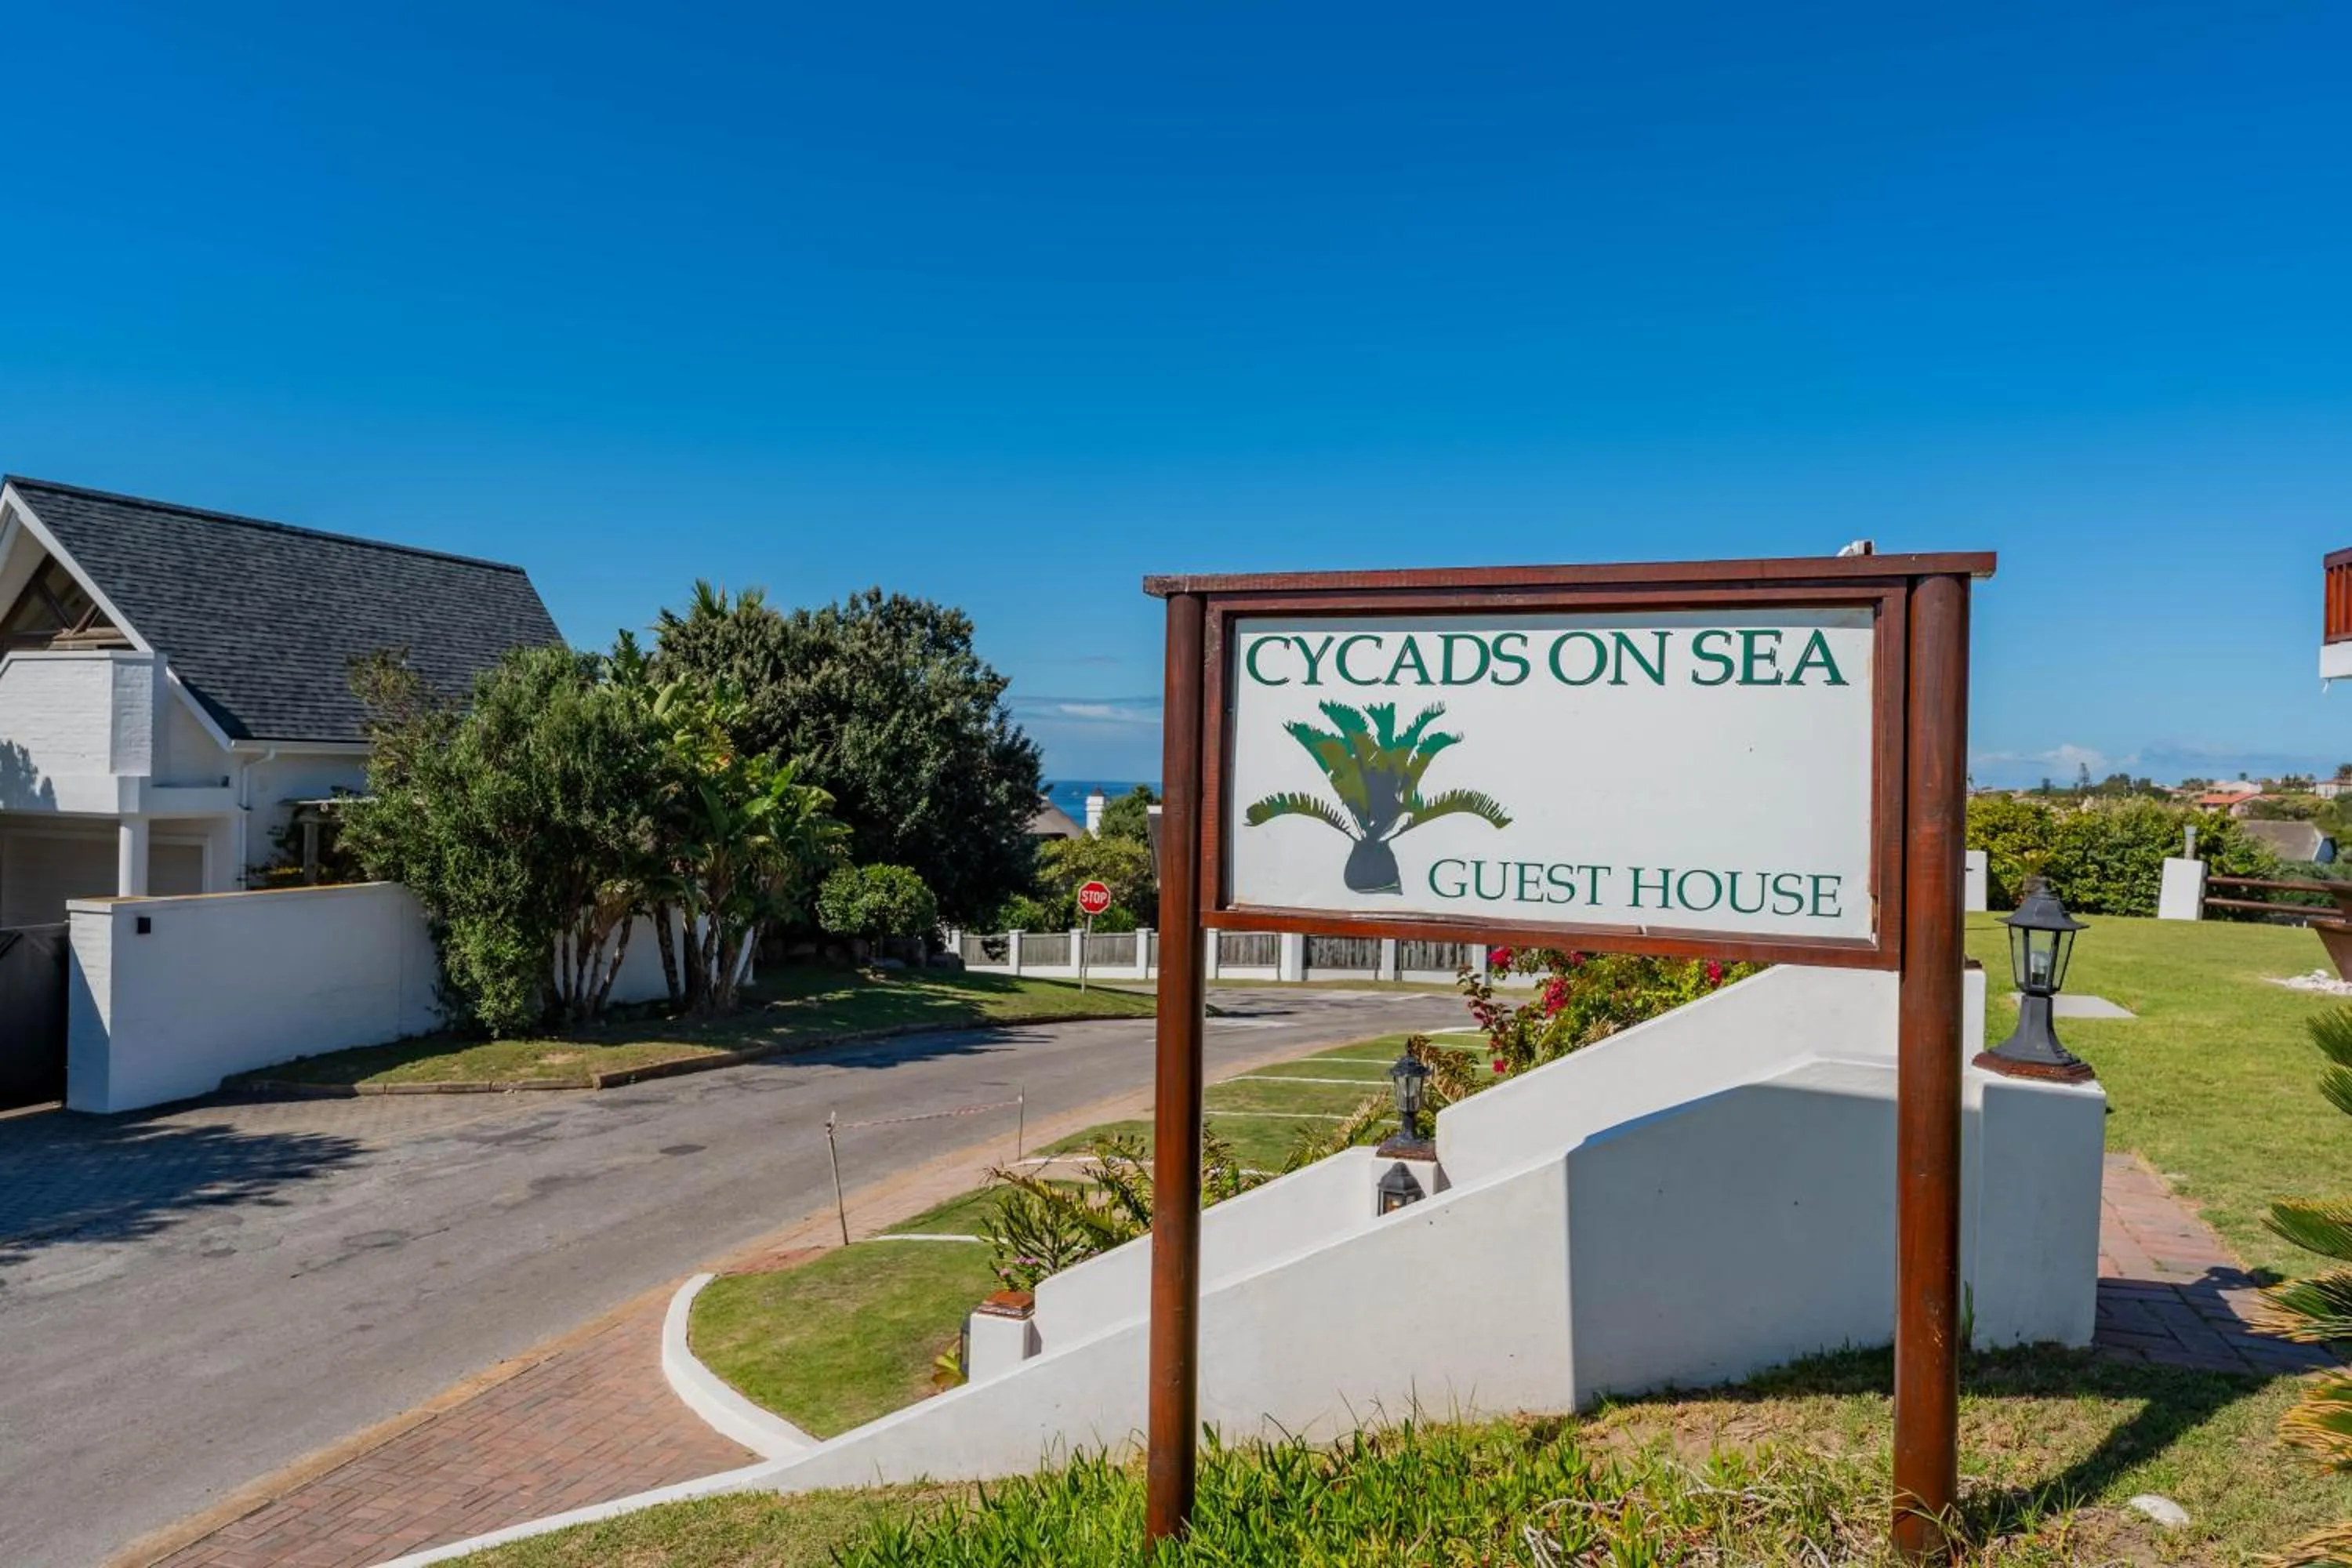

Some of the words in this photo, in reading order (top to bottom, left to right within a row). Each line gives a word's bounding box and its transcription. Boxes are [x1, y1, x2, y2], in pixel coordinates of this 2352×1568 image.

[1246, 632, 1531, 687] CYCADS
[1548, 630, 1674, 686] ON
[1691, 629, 1850, 687] SEA
[1081, 890, 1108, 904] STOP
[1428, 858, 1611, 906] GUEST
[1628, 866, 1842, 918] HOUSE
